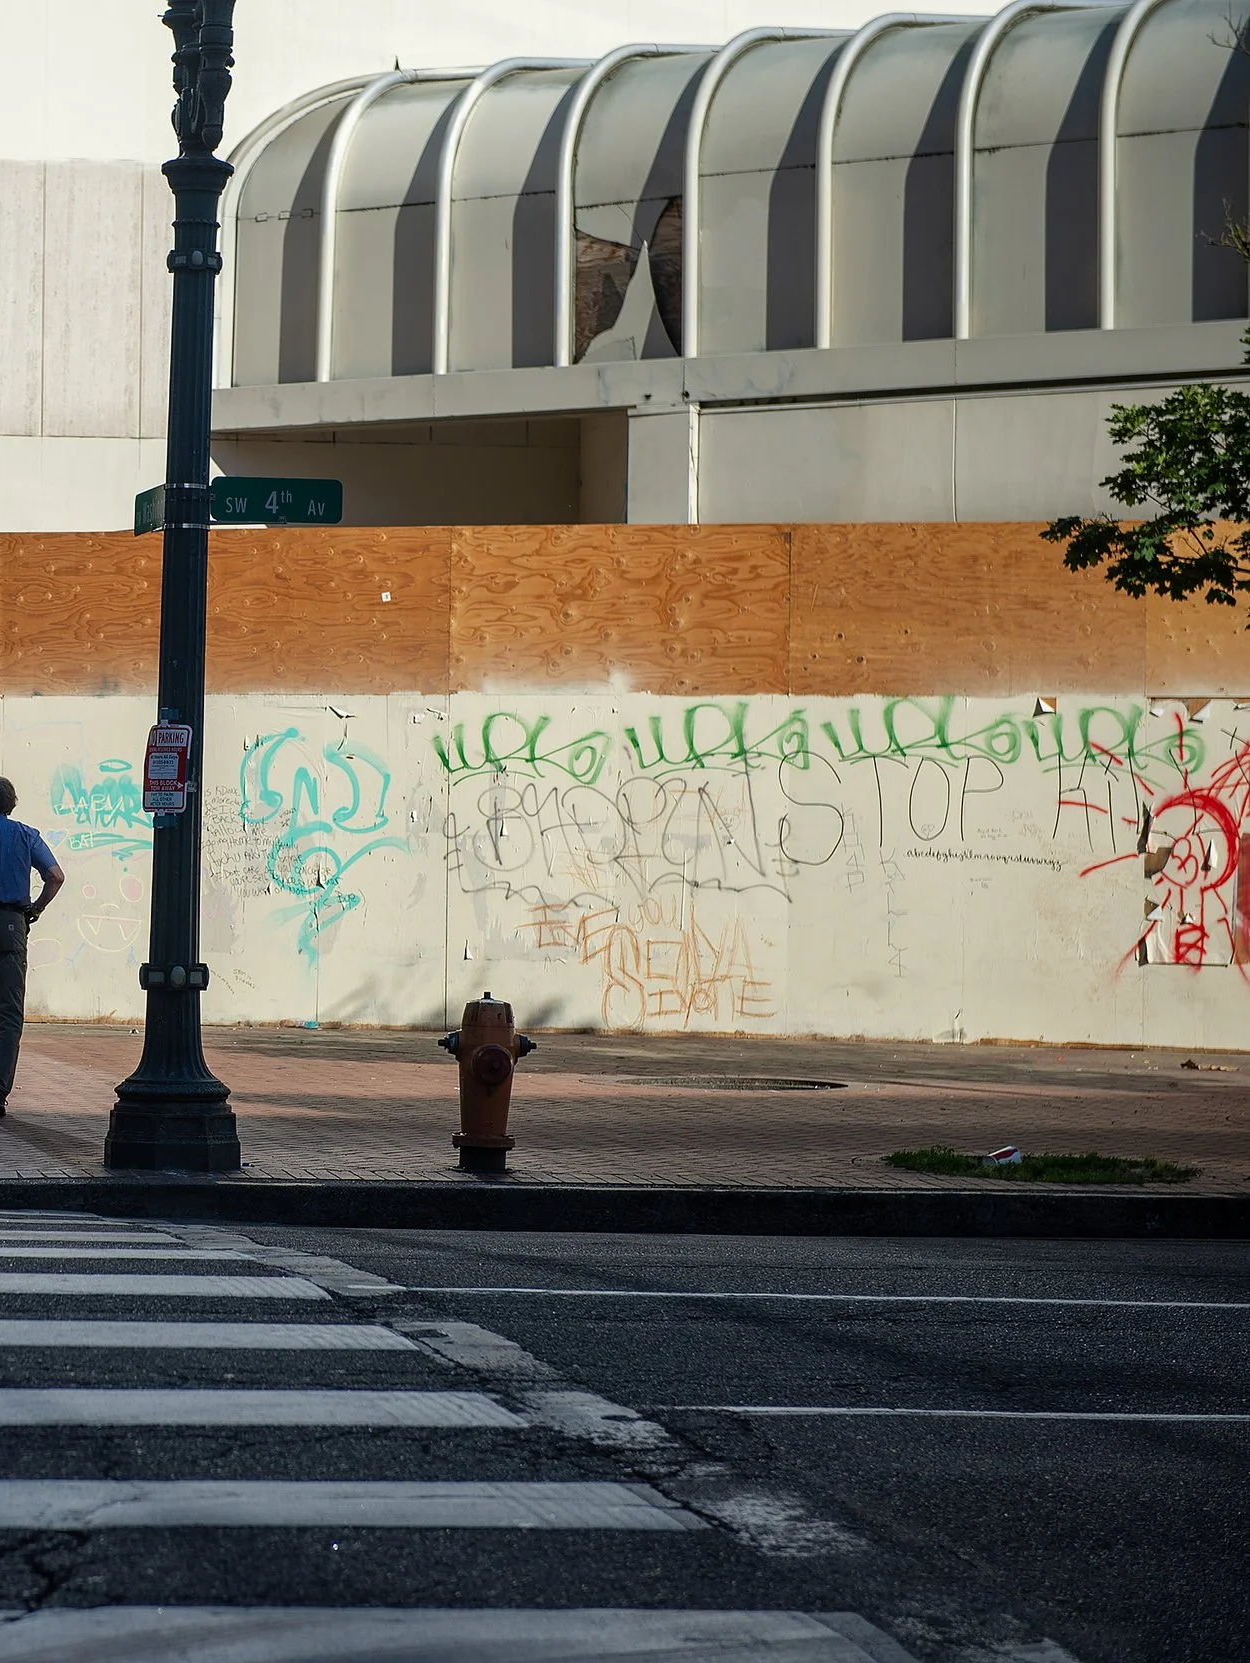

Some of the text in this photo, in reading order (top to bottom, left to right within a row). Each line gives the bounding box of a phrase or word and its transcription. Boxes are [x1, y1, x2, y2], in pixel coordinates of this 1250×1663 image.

[225, 490, 326, 516] SW 4th Av
[158, 731, 185, 744] PARKING
[778, 751, 1005, 867] STOP
